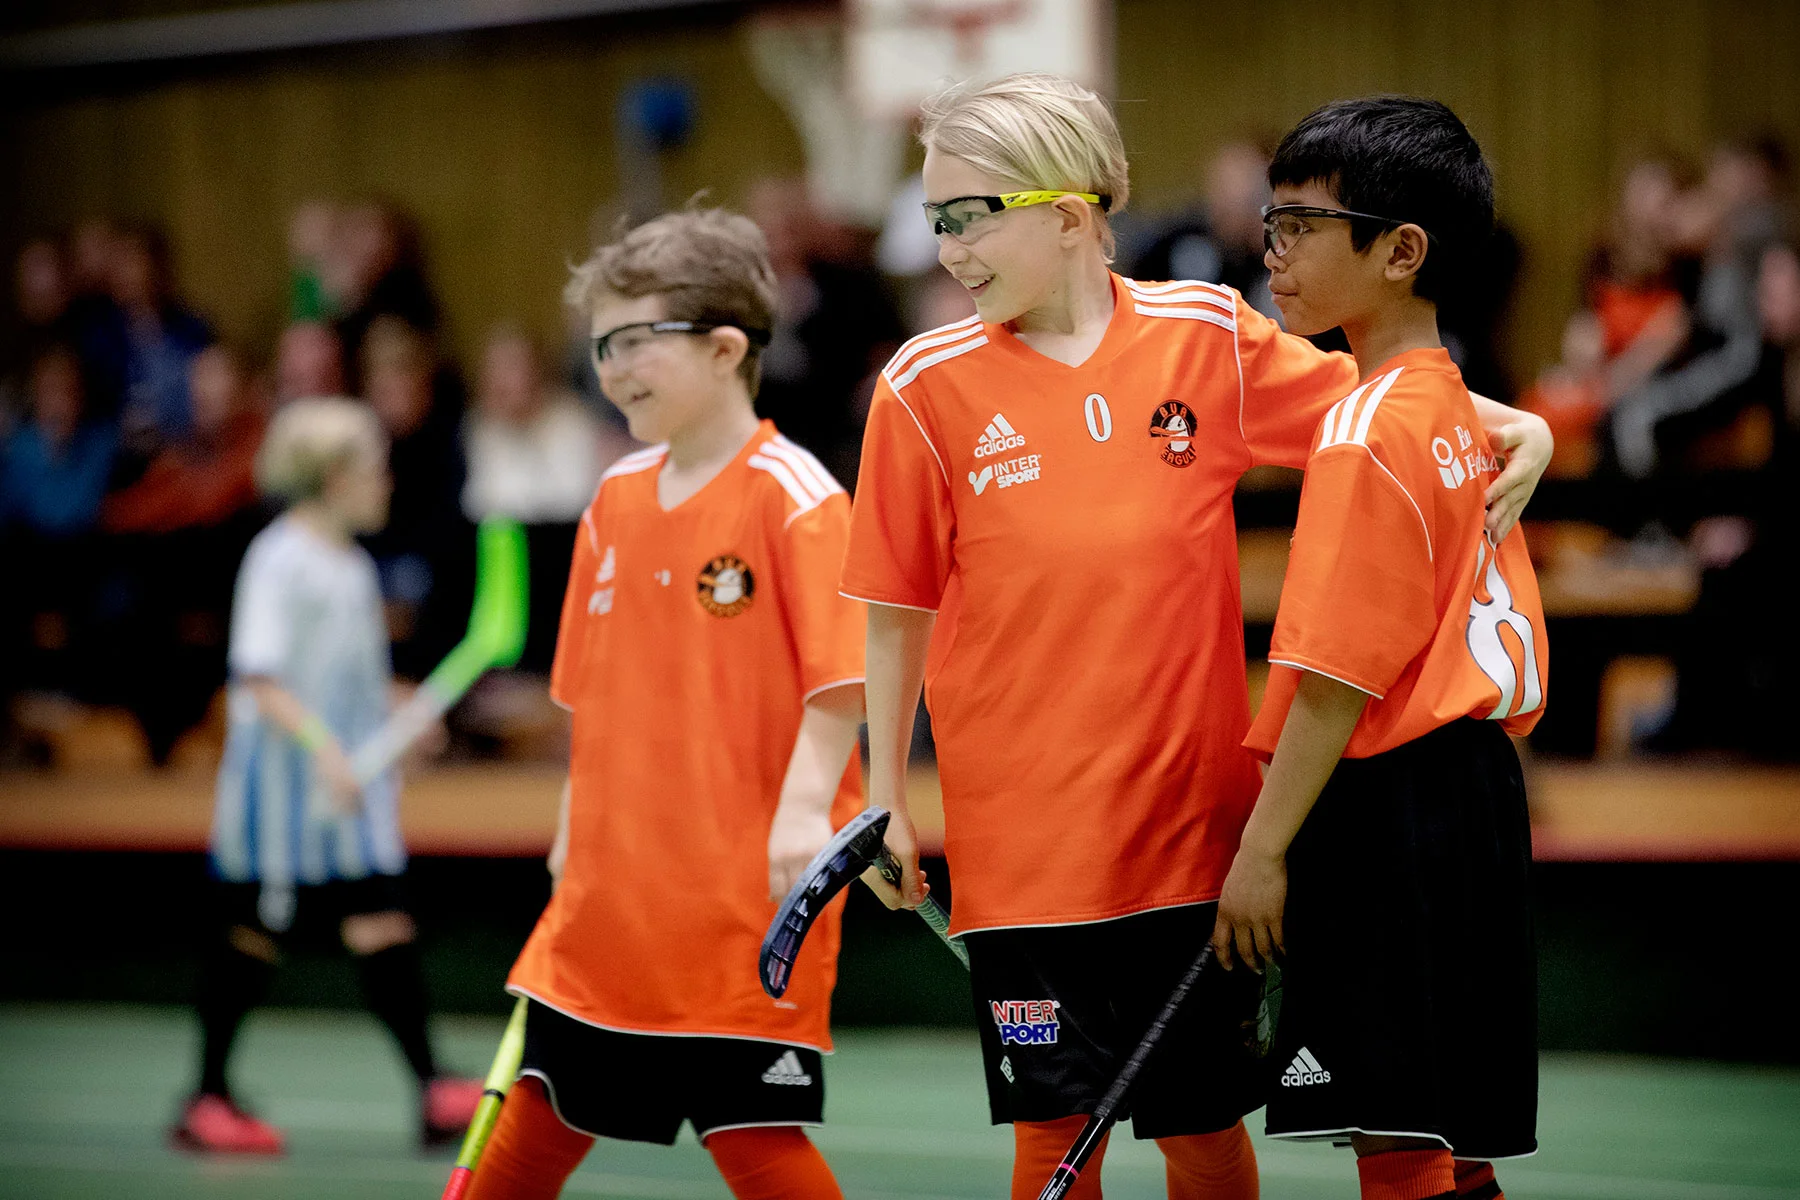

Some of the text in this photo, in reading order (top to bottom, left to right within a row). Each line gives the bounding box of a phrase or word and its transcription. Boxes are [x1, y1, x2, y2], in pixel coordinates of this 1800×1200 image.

[1083, 392, 1113, 443] 0
[1159, 403, 1187, 418] BUA
[974, 434, 1026, 459] adidas
[994, 454, 1039, 477] INTER
[996, 466, 1041, 489] SPORT
[991, 1000, 1058, 1023] NTER
[1000, 1022, 1060, 1045] PORT
[1281, 1070, 1331, 1087] adidas
